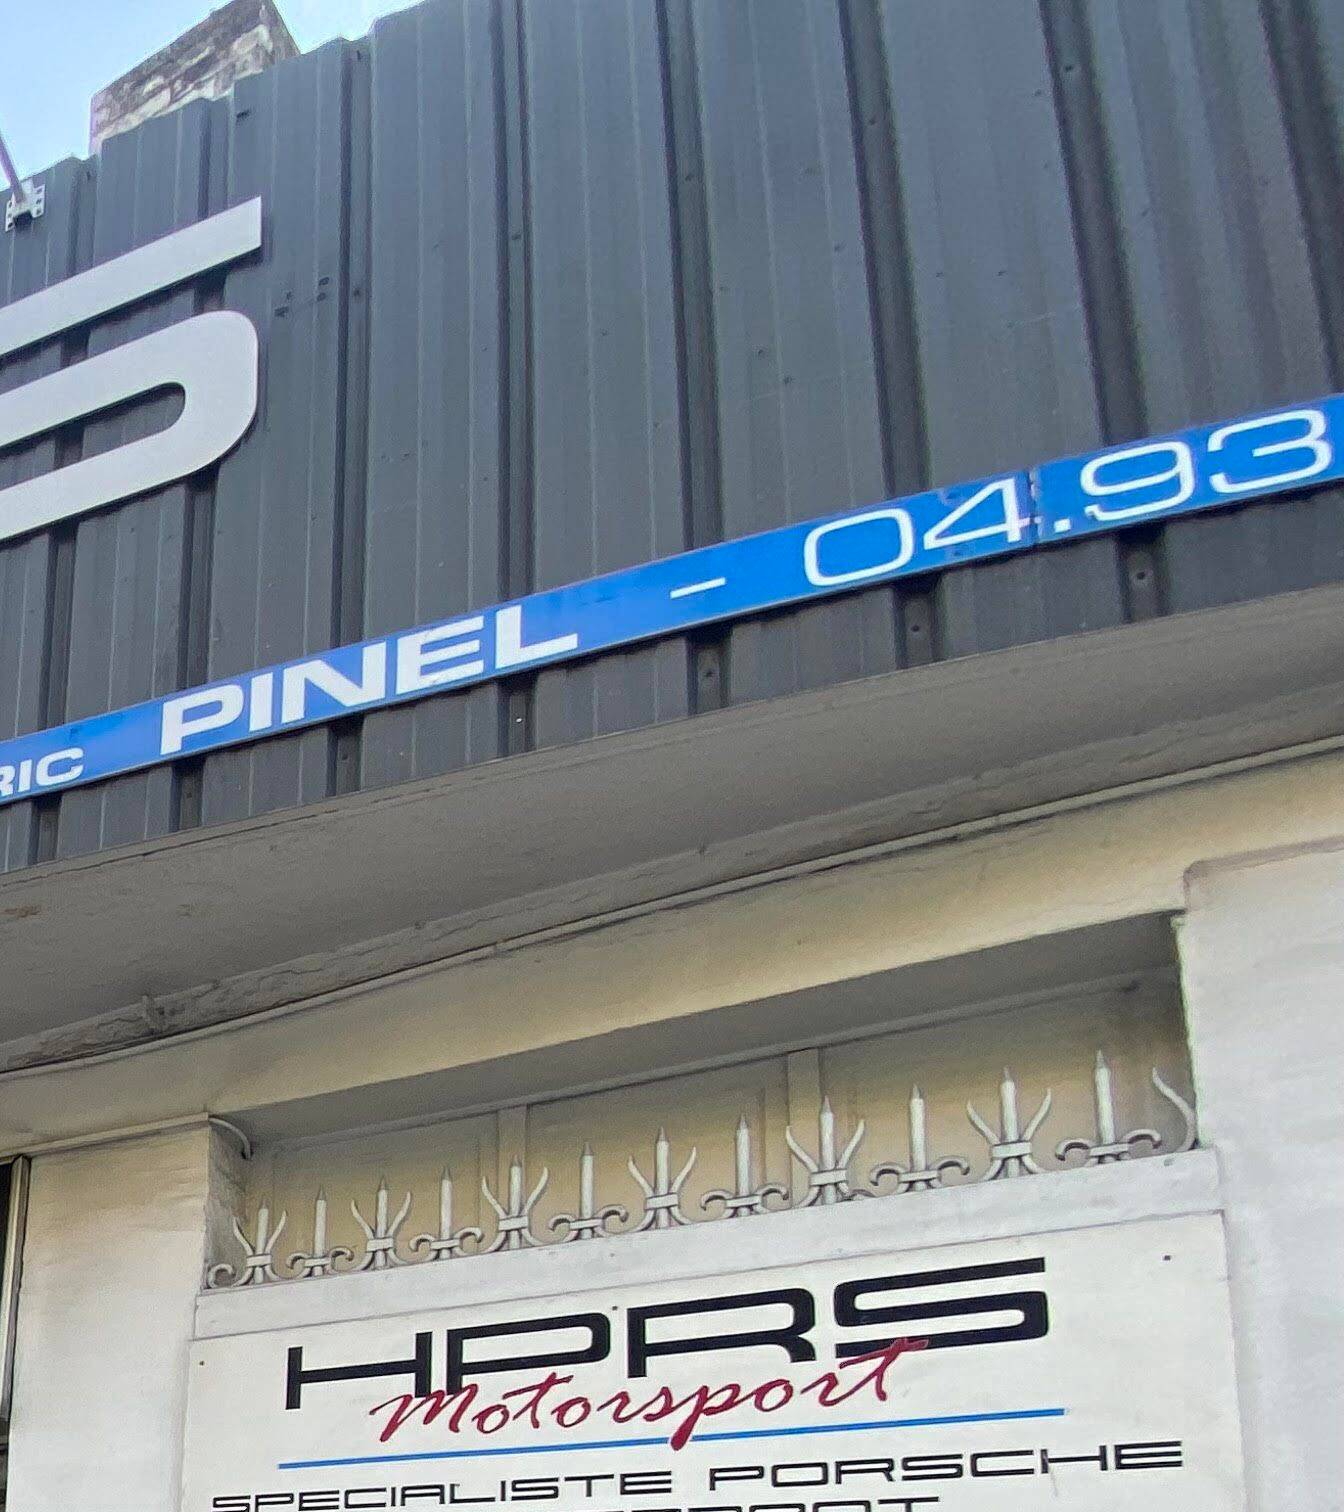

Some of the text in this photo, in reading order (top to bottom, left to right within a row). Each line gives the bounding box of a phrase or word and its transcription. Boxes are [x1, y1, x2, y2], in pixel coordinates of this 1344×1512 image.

[158, 602, 579, 757] PINEL
[802, 408, 1335, 588] 04.93
[286, 1257, 1050, 1410] HPRS
[370, 1338, 932, 1450] Motorsport
[708, 1440, 1184, 1493] PORSCHE
